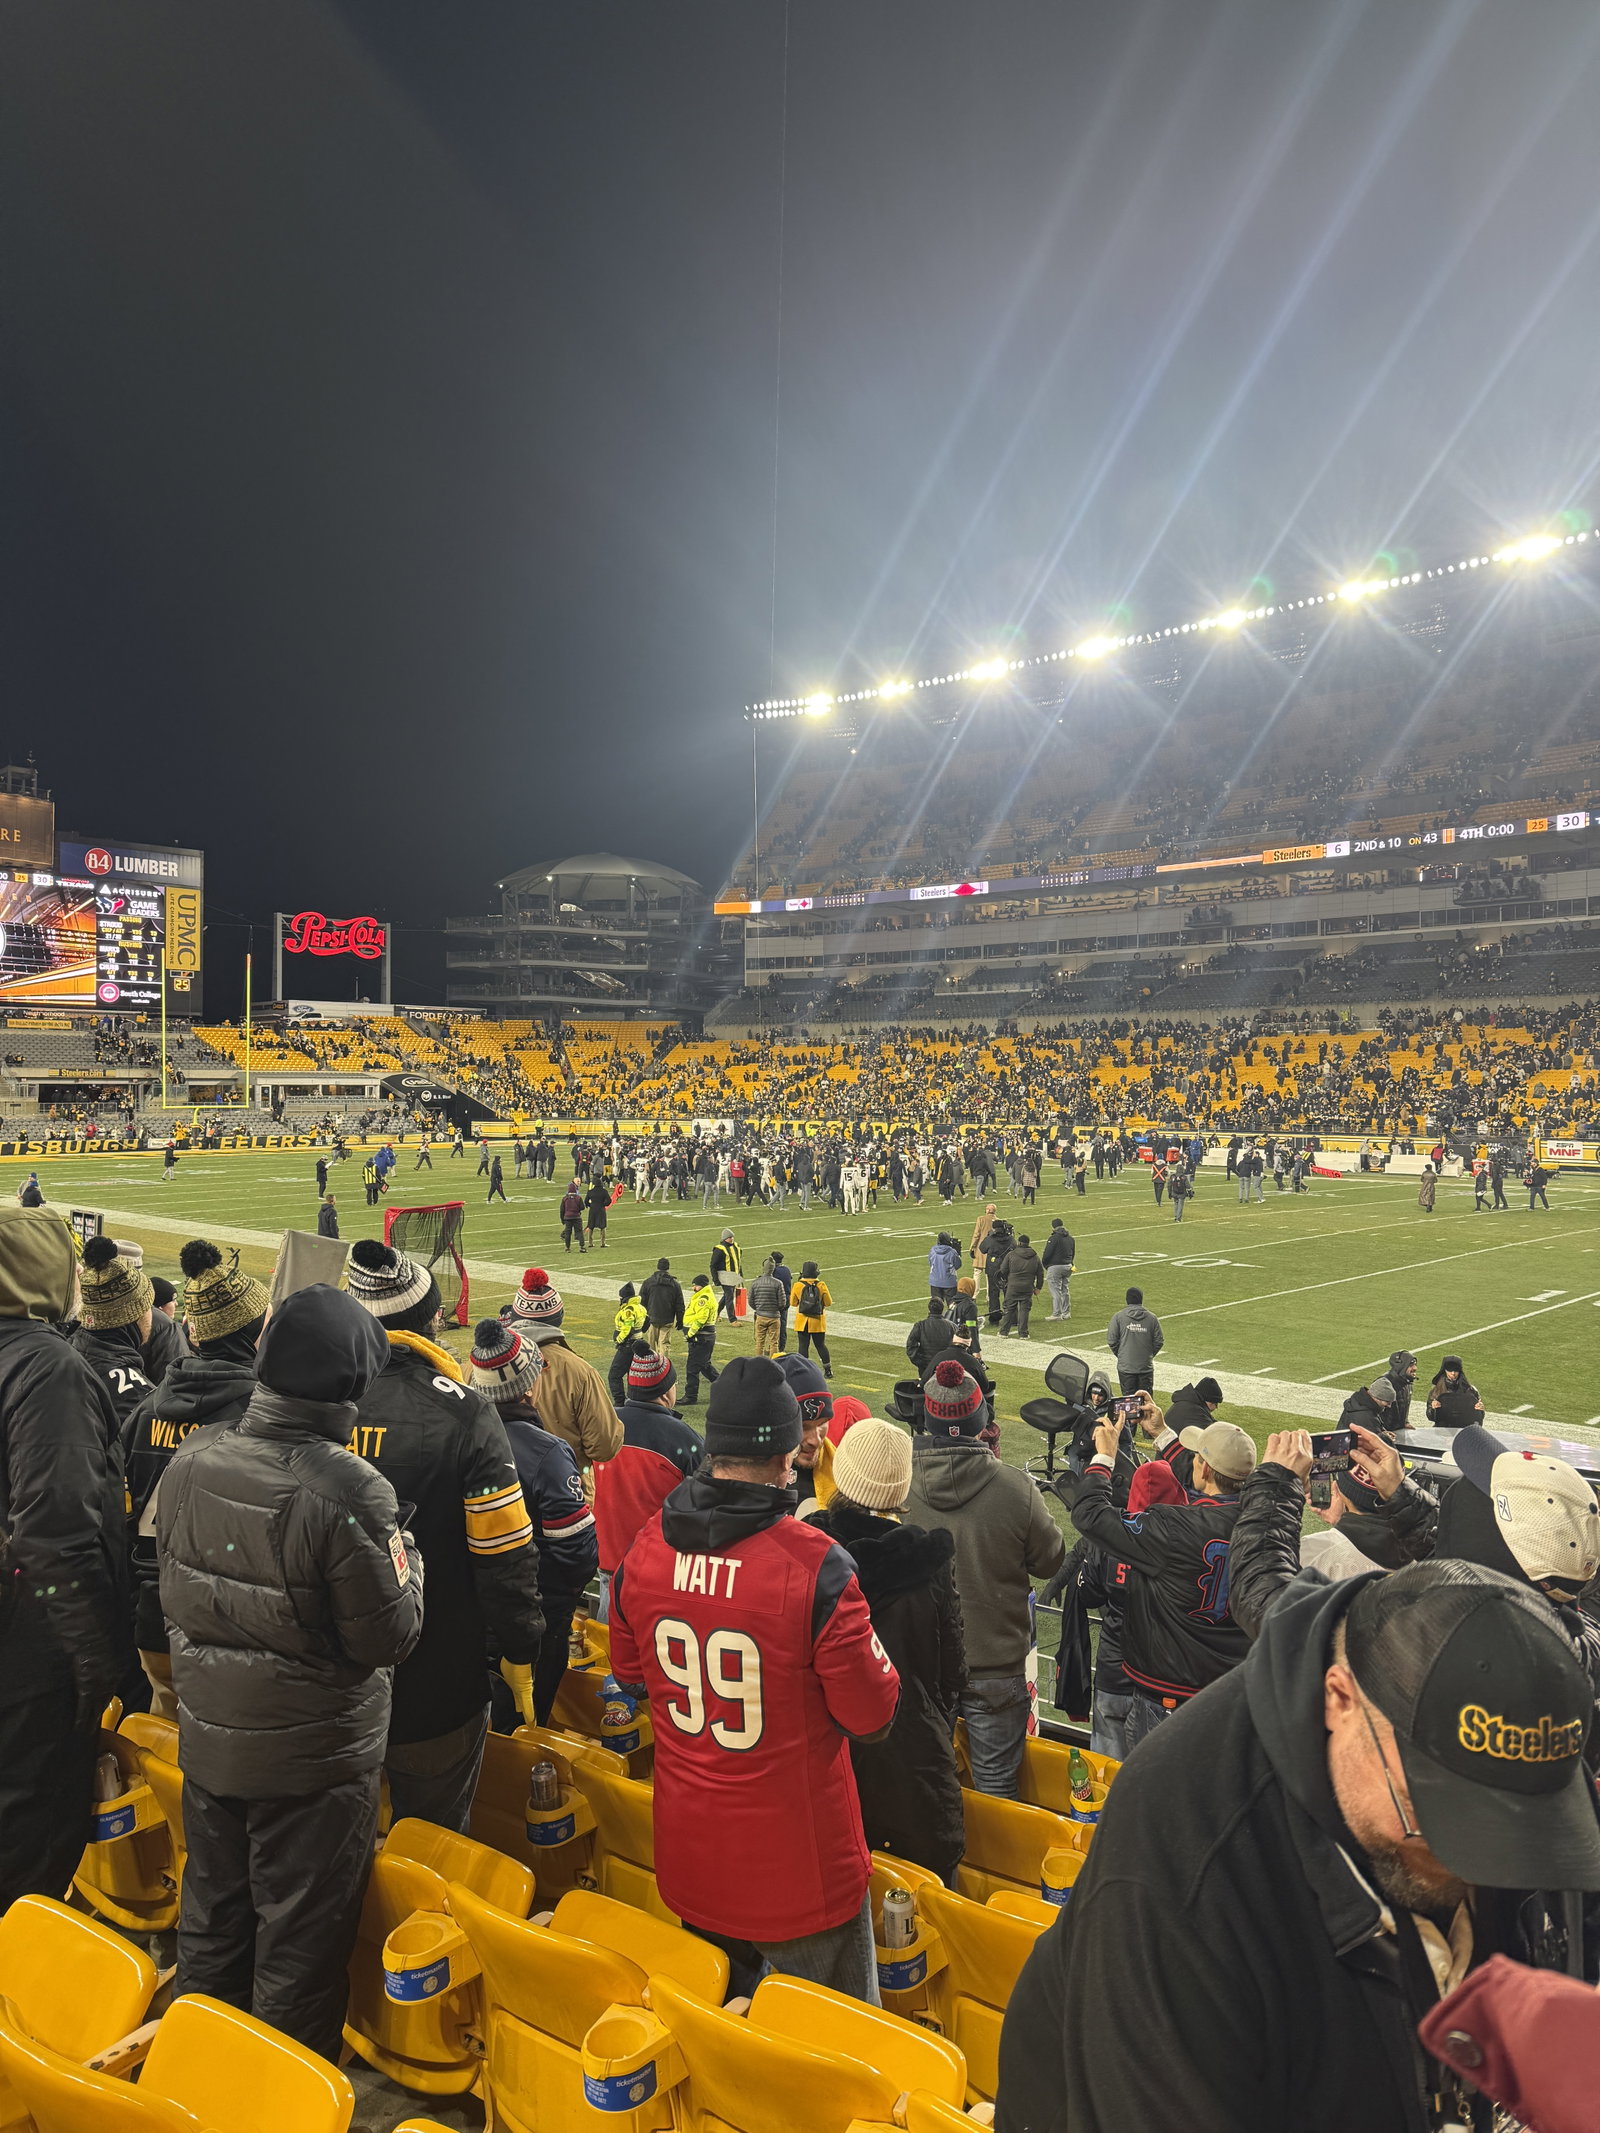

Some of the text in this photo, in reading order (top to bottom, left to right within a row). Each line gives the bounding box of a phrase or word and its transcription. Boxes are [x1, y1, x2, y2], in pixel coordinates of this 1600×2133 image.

[1532, 821, 1543, 830] 25
[1563, 816, 1579, 827] 30
[1460, 824, 1514, 840] 4TH 0:00
[1335, 844, 1342, 854] 6
[1355, 833, 1437, 852] 2ND & 10 ON 43
[1274, 849, 1312, 862] Steelers
[87, 853, 178, 877] 84 LUMBER
[112, 887, 158, 898] ACRISURE
[920, 887, 947, 898] Steelers
[127, 907, 160, 917] LEADERS
[130, 901, 158, 911] GAME
[177, 894, 197, 966] UPMC
[175, 980, 190, 990] 25
[120, 990, 161, 999] South College
[410, 1011, 435, 1021] FORD
[61, 1068, 104, 1078] Steelers.com
[189, 1134, 312, 1150] SEELERS
[1549, 1147, 1582, 1157] MNF
[844, 1172, 853, 1181] 15
[861, 1170, 867, 1178] 6
[515, 1296, 558, 1312] TEXANS
[108, 1367, 148, 1394] 24
[432, 1375, 467, 1400] 9
[926, 1397, 976, 1418] TEXANS
[673, 1550, 743, 1599] WATT
[1115, 1562, 1132, 1585] S
[869, 1630, 892, 1675] 9
[653, 1616, 764, 1752] 99
[1458, 1704, 1583, 1762] Steelers
[410, 1961, 446, 1980] ticketmaster
[615, 2066, 653, 2088] ticketmaster
